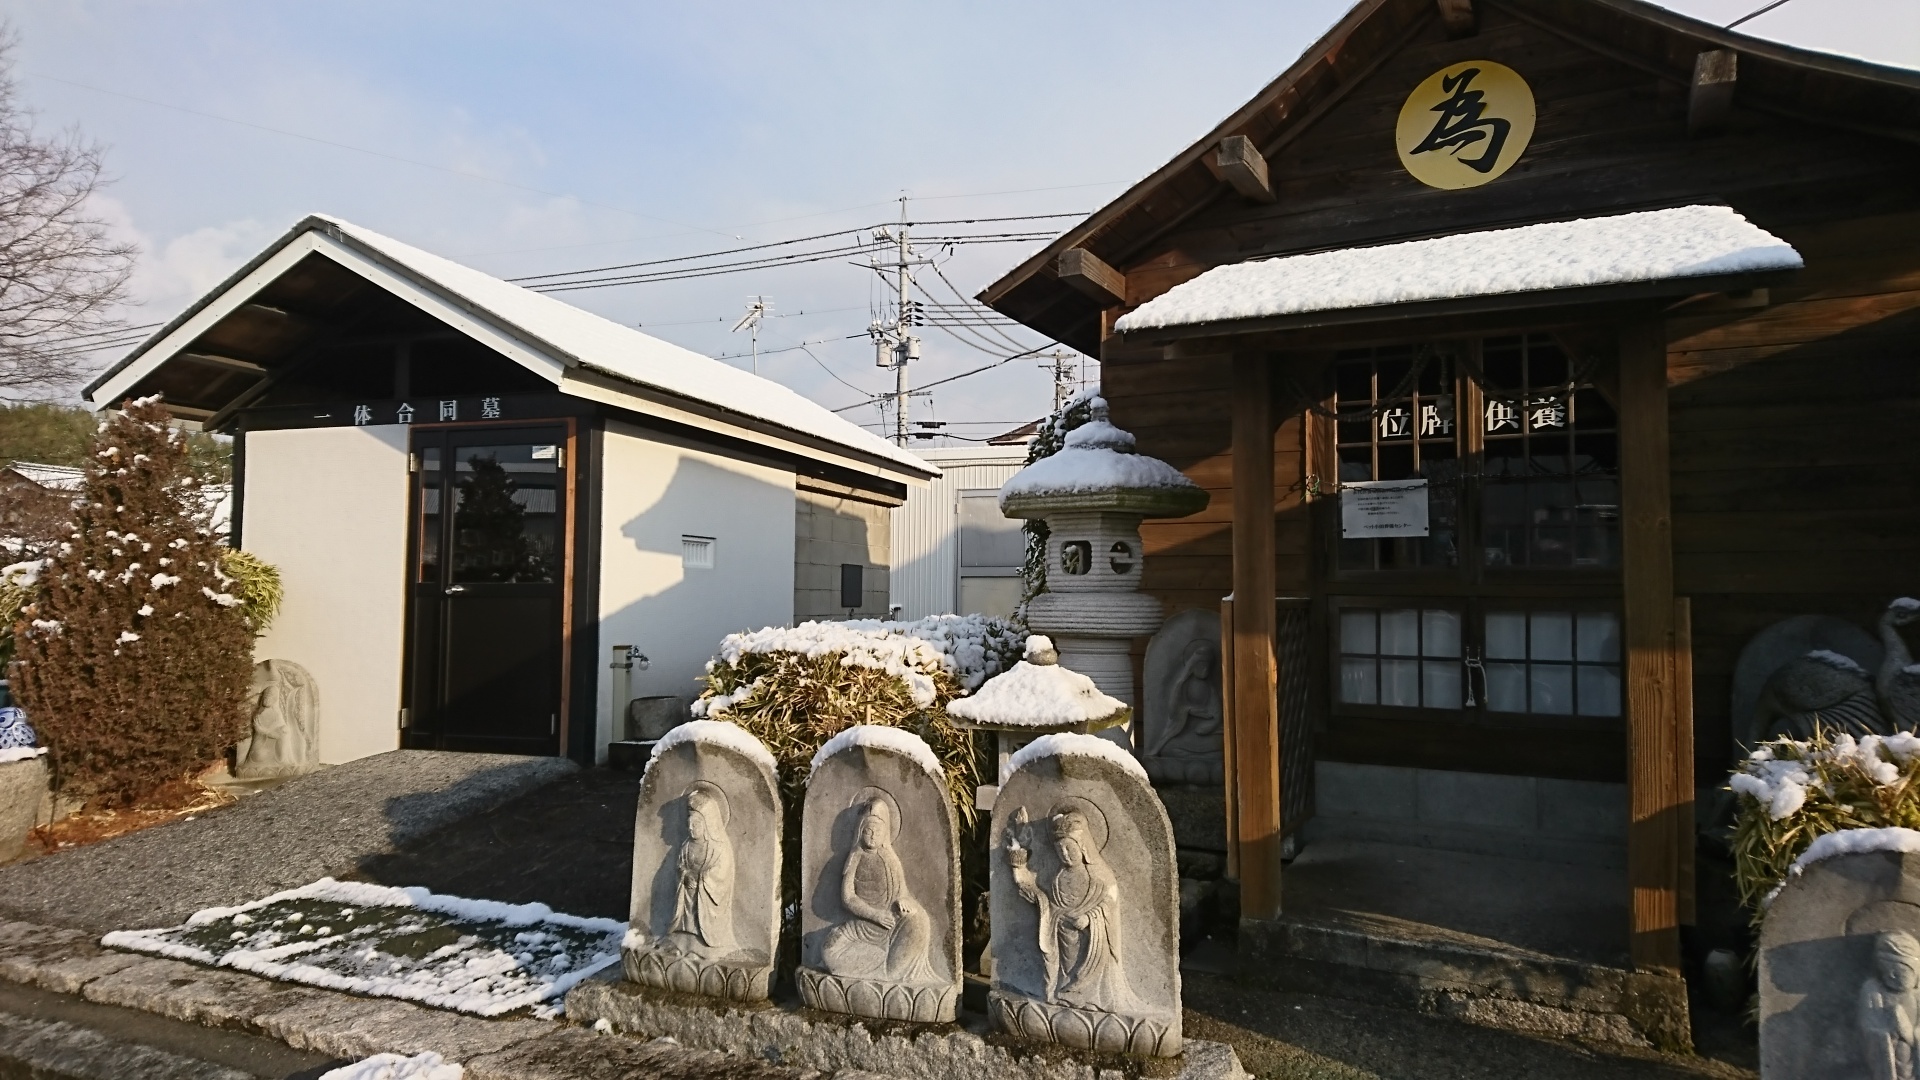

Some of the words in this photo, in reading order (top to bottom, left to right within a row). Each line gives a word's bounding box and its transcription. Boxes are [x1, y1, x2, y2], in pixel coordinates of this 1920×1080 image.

[313, 397, 500, 426] 一体合同墓
